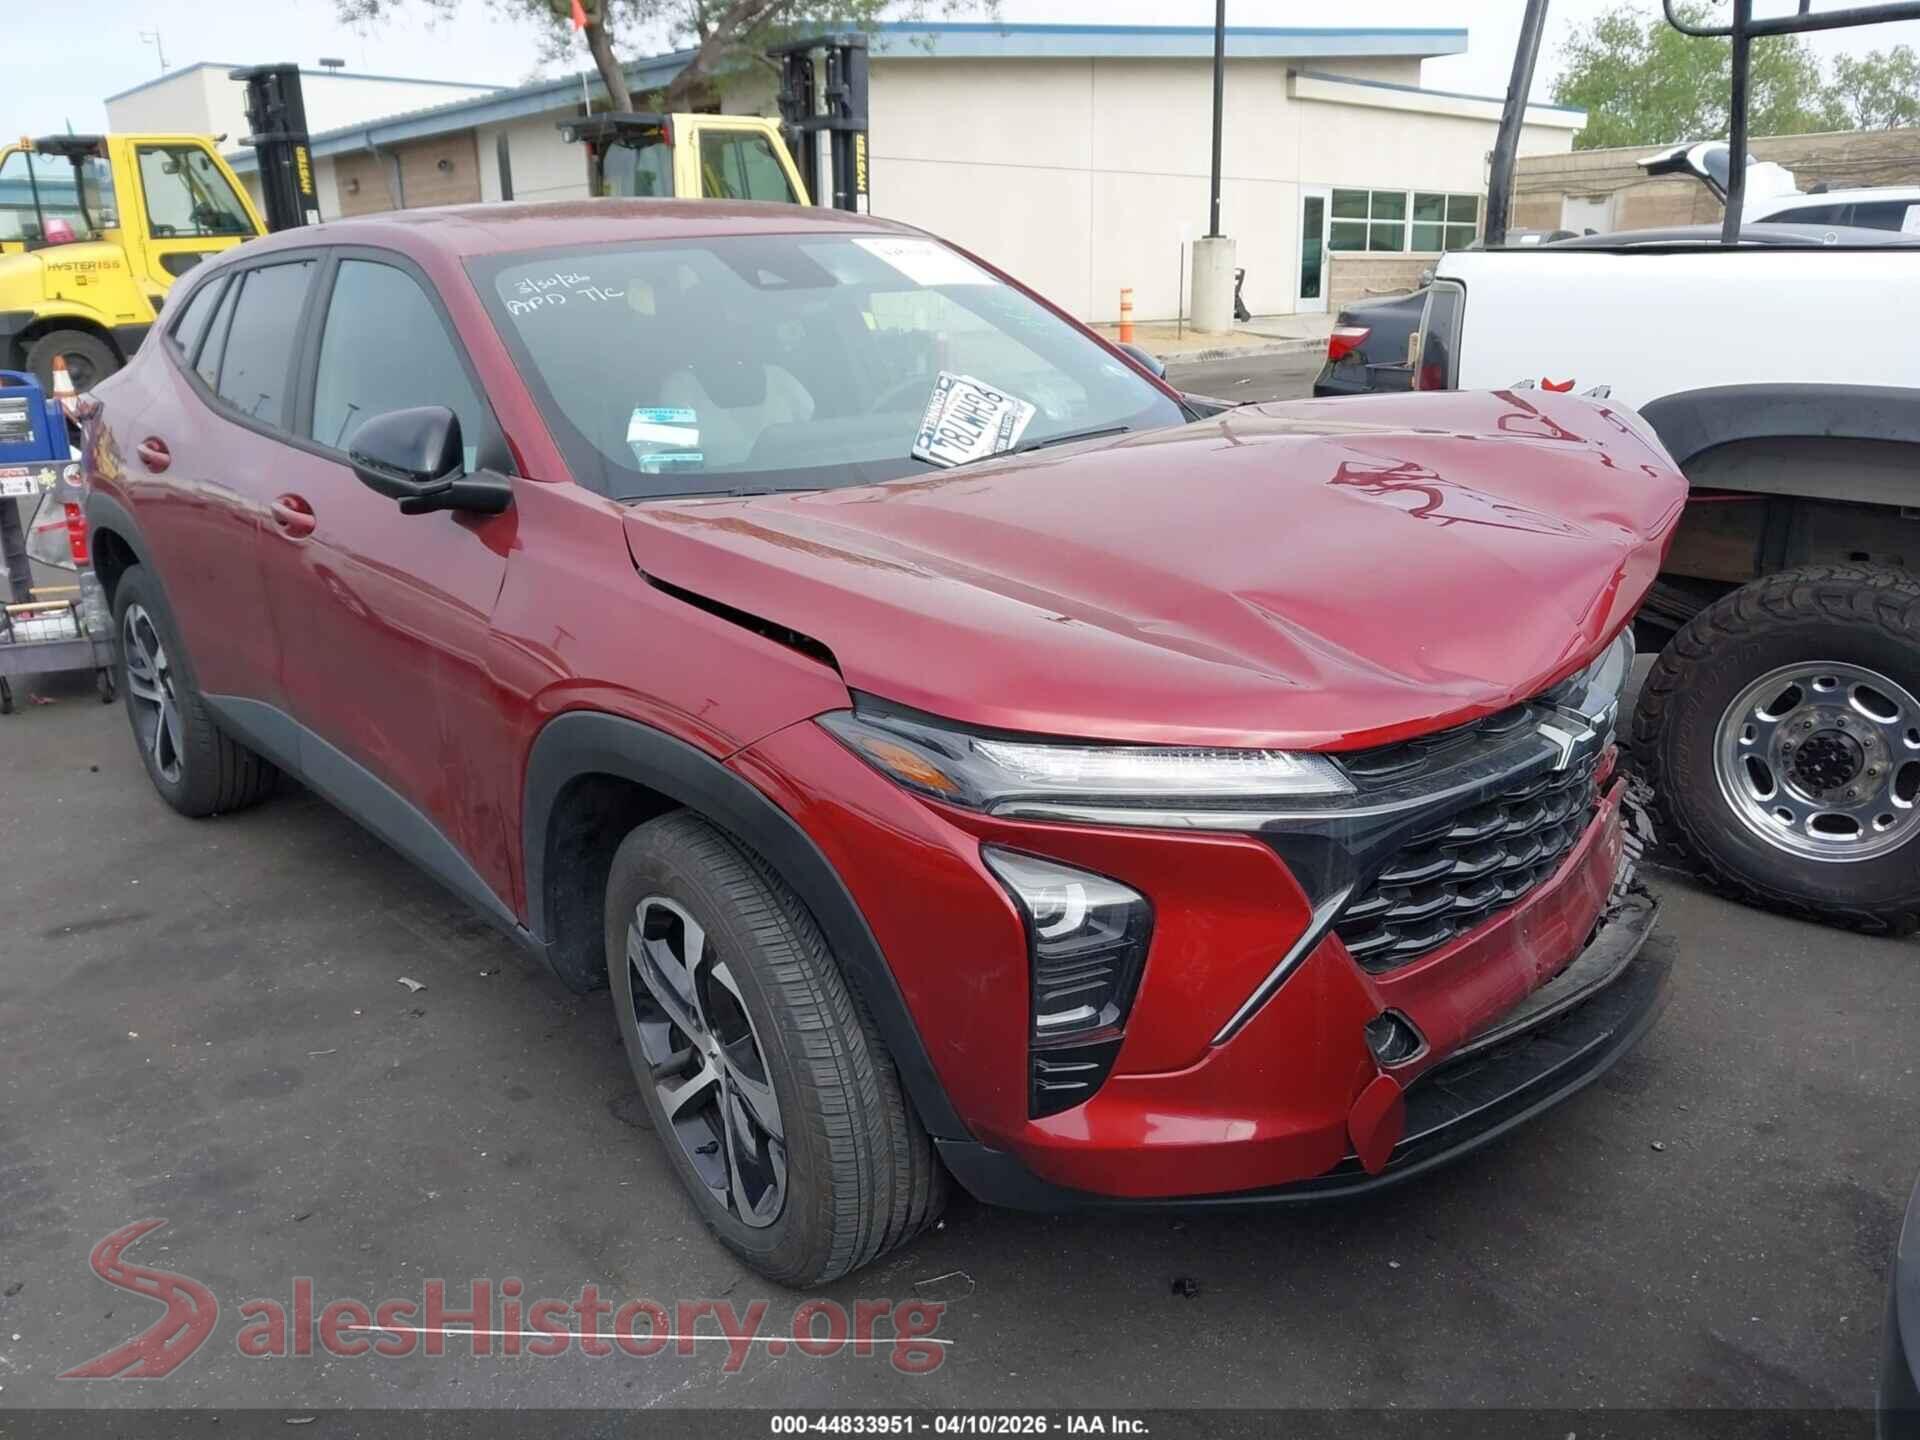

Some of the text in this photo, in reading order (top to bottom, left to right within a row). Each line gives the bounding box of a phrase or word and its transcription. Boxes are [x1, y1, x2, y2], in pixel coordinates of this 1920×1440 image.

[296, 145, 312, 195] HYSTER
[856, 133, 867, 193] HYSTER
[47, 260, 96, 272] HYSTER
